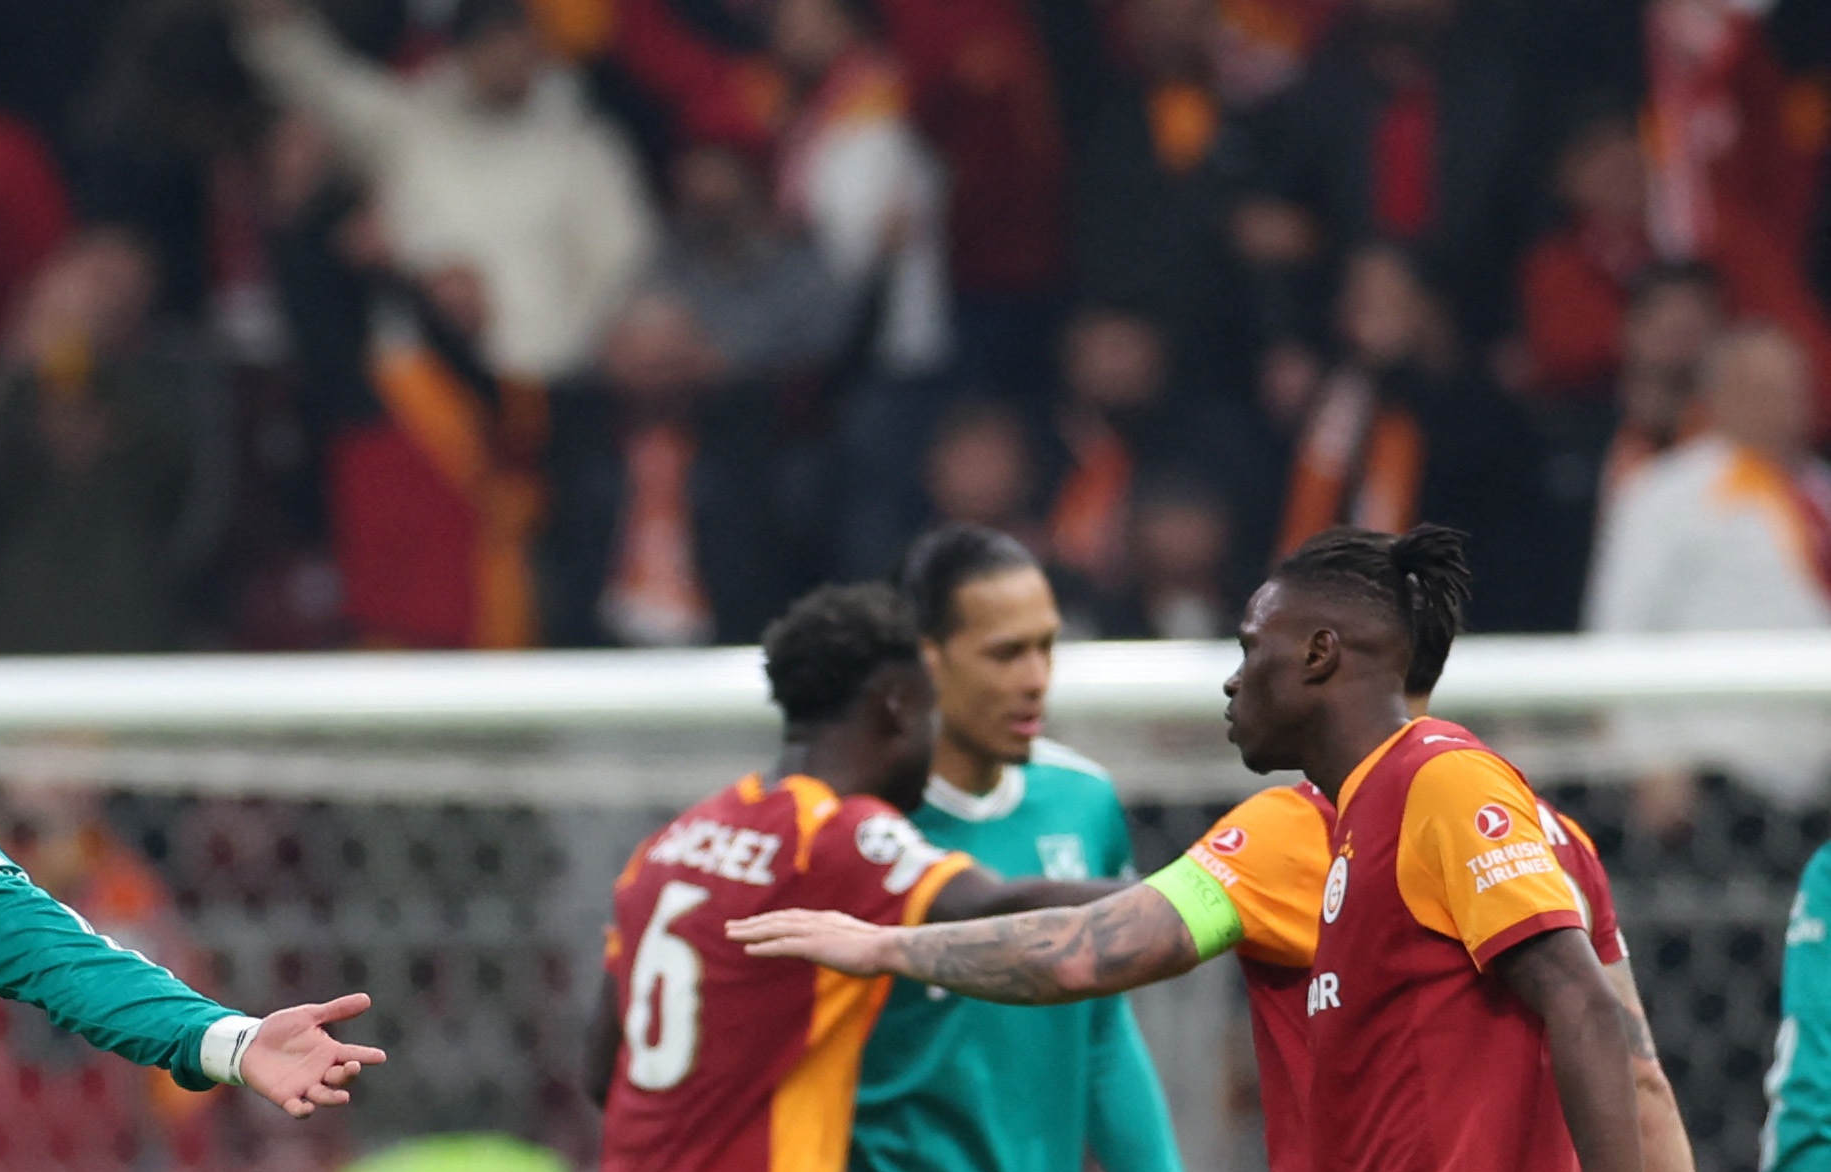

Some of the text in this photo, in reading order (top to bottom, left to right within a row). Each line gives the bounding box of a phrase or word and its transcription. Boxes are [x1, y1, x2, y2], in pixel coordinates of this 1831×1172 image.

[1186, 843, 1240, 888] RKISH
[1466, 841, 1546, 875] TURKISH
[1475, 857, 1554, 894] AIRLINES
[625, 880, 710, 1092] 6
